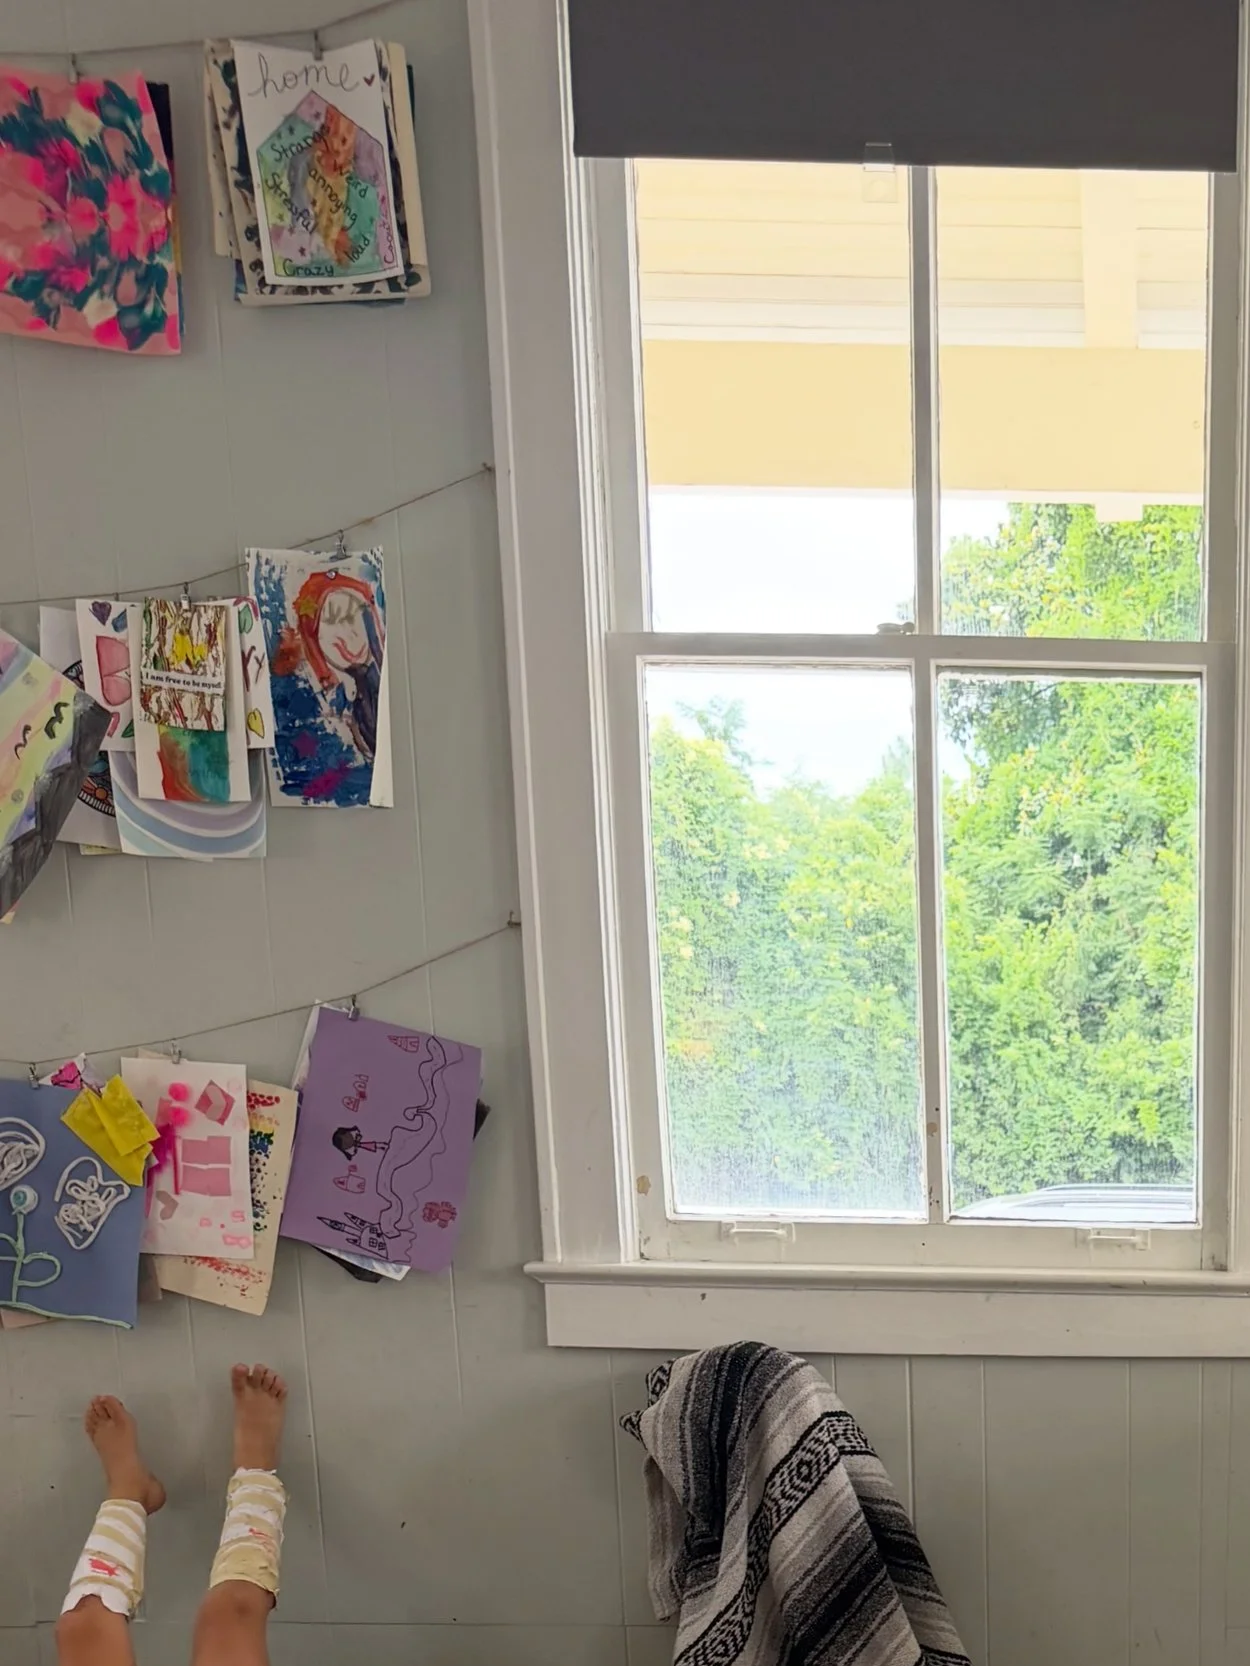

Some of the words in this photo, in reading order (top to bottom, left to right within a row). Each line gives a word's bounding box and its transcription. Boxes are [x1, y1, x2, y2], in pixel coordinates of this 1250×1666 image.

[248, 52, 360, 98] home
[264, 171, 318, 235] Stressful
[308, 168, 358, 232] annoying
[343, 234, 371, 263] loud
[282, 258, 335, 277] Crazy
[165, 675, 181, 685] free
[192, 680, 201, 688] be
